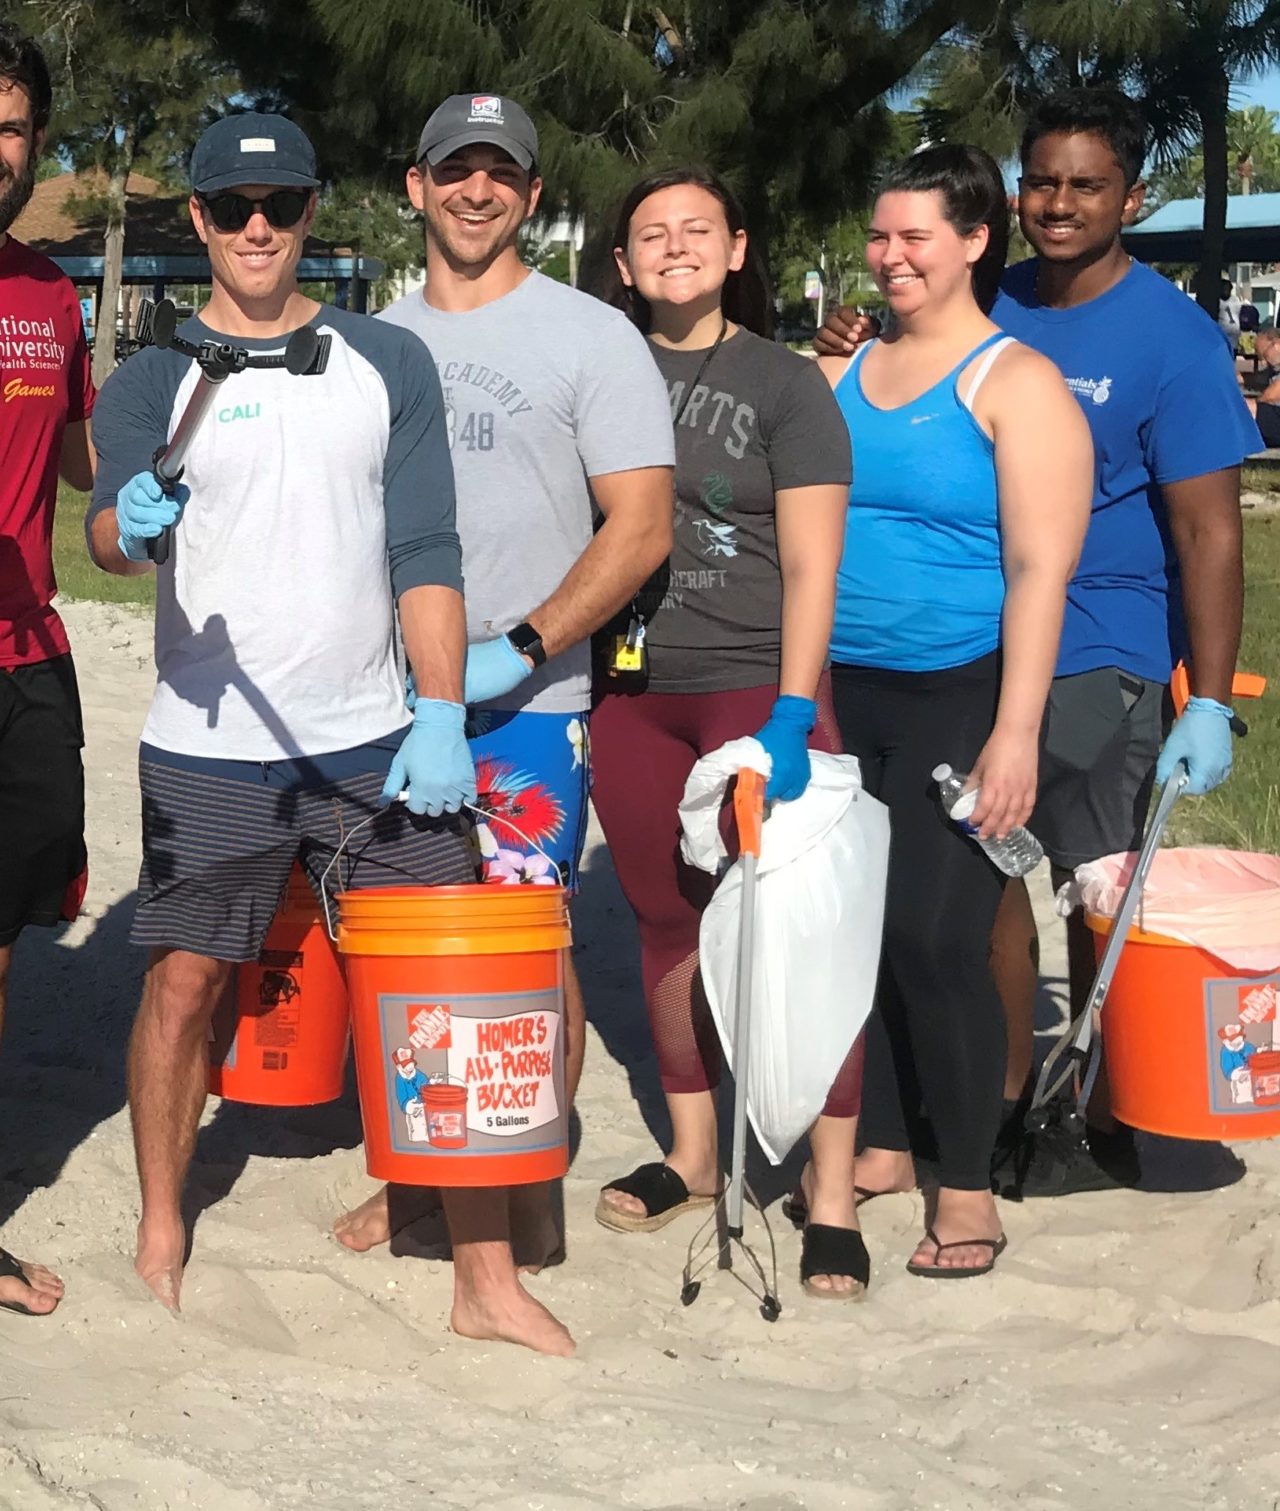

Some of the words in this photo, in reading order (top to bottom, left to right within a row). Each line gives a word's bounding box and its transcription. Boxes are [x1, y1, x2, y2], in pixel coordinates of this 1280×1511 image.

[3, 377, 56, 403] Games
[436, 361, 533, 418] CADEMY
[218, 402, 261, 423] CALI
[668, 379, 756, 460] ARTS
[669, 569, 728, 589] HCRAFT
[476, 1015, 548, 1054] HOMER'S
[476, 1081, 540, 1113] BUCKET
[486, 1116, 494, 1127] 5
[495, 1115, 530, 1127] Gallons
